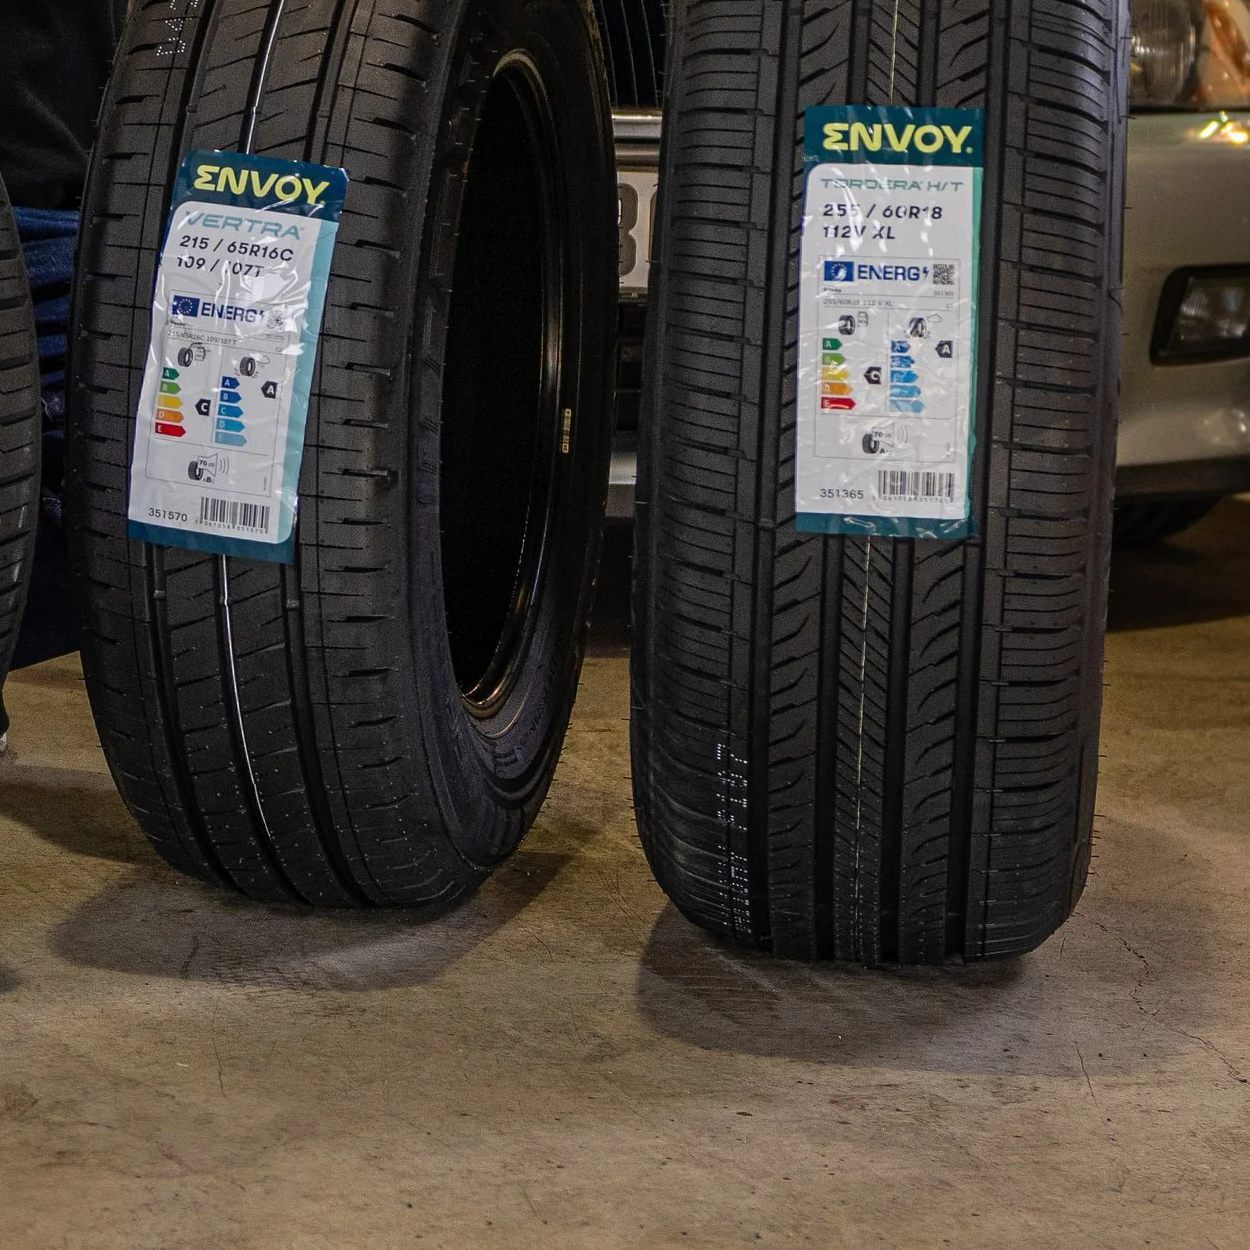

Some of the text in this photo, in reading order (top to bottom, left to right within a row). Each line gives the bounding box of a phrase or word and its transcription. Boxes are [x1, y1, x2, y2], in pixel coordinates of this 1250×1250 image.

[822, 121, 972, 154] ENVOY
[194, 165, 330, 206] ENVOY
[823, 203, 860, 217] 255
[866, 203, 876, 218] /
[872, 226, 896, 240] XL
[179, 235, 294, 262] 215 / 65R16C
[177, 256, 206, 270] 109
[209, 258, 220, 273] /
[857, 264, 920, 281] ENERG
[942, 345, 951, 354] A
[266, 385, 275, 395] A
[201, 402, 208, 412] C
[820, 488, 864, 499] 351365
[148, 507, 188, 523] 351570
